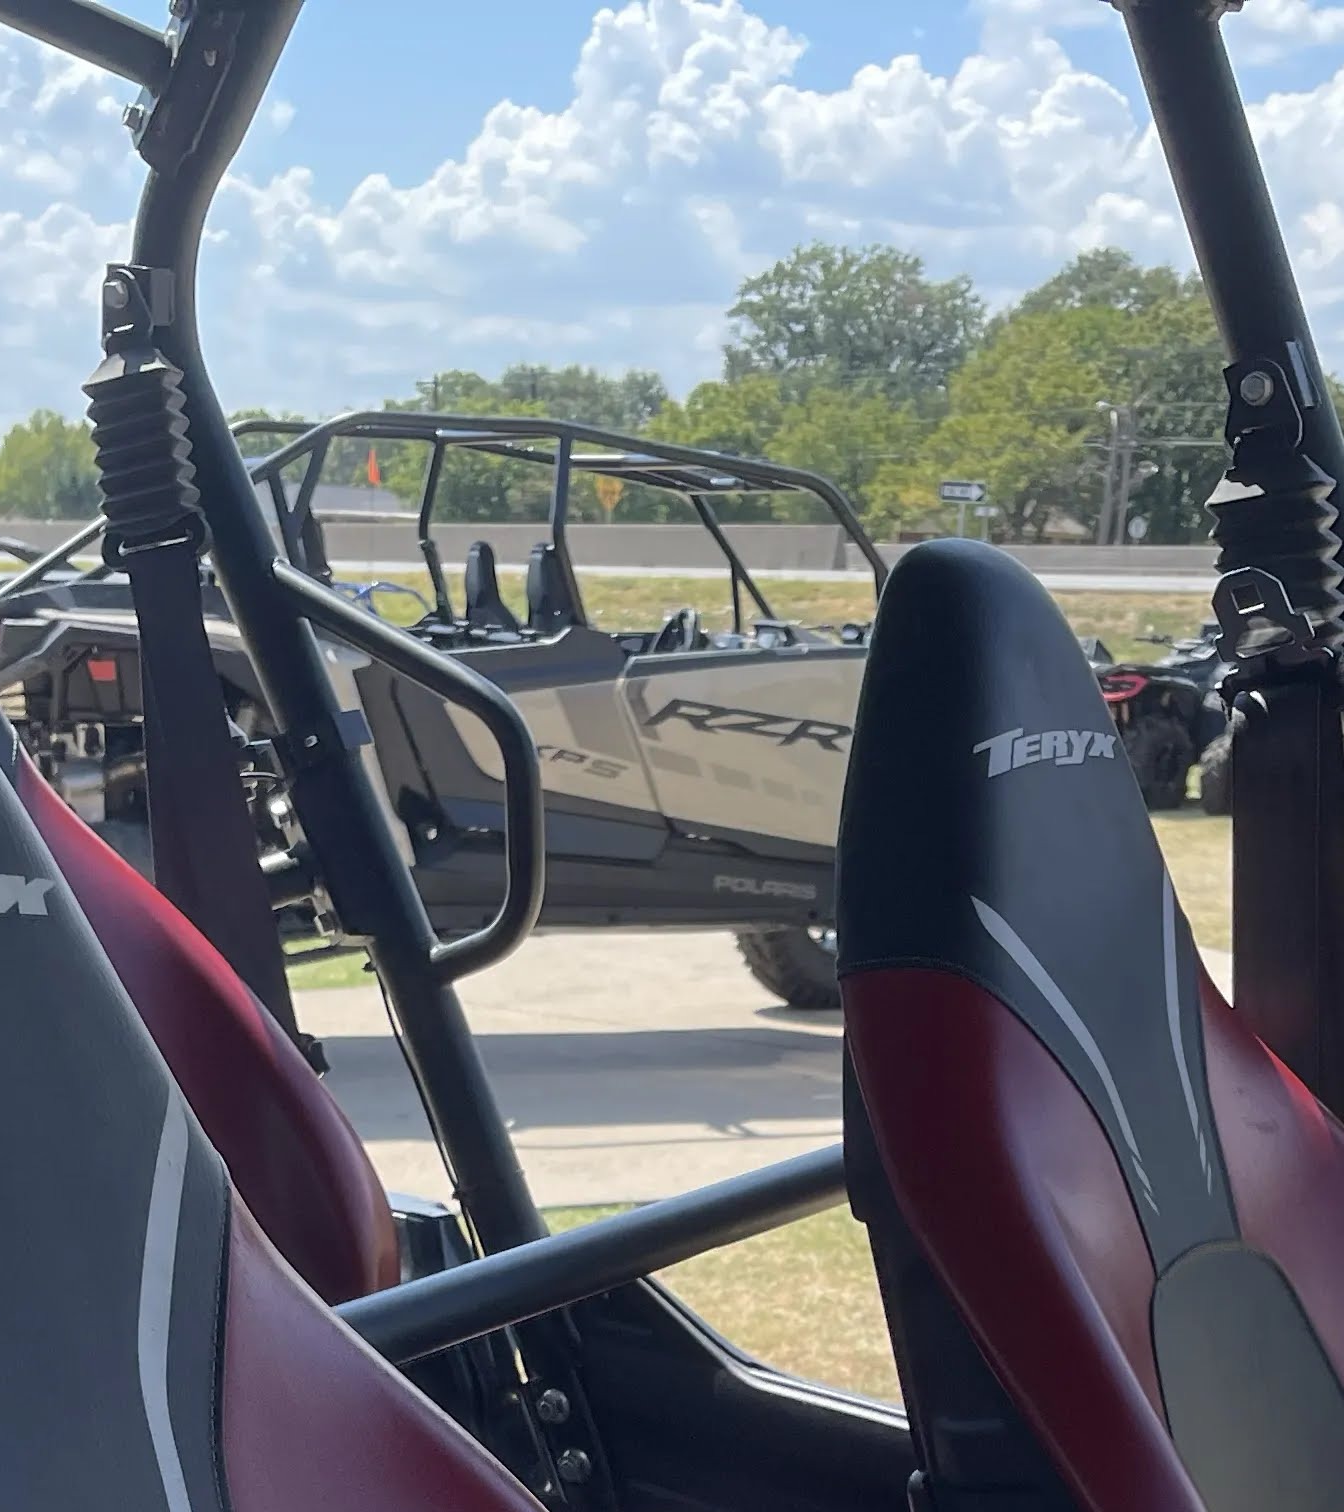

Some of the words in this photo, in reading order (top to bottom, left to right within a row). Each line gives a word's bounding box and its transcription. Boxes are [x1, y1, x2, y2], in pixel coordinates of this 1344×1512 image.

[644, 699, 852, 752] RZR
[973, 727, 1116, 778] TERYX
[713, 875, 816, 900] POLARIS
